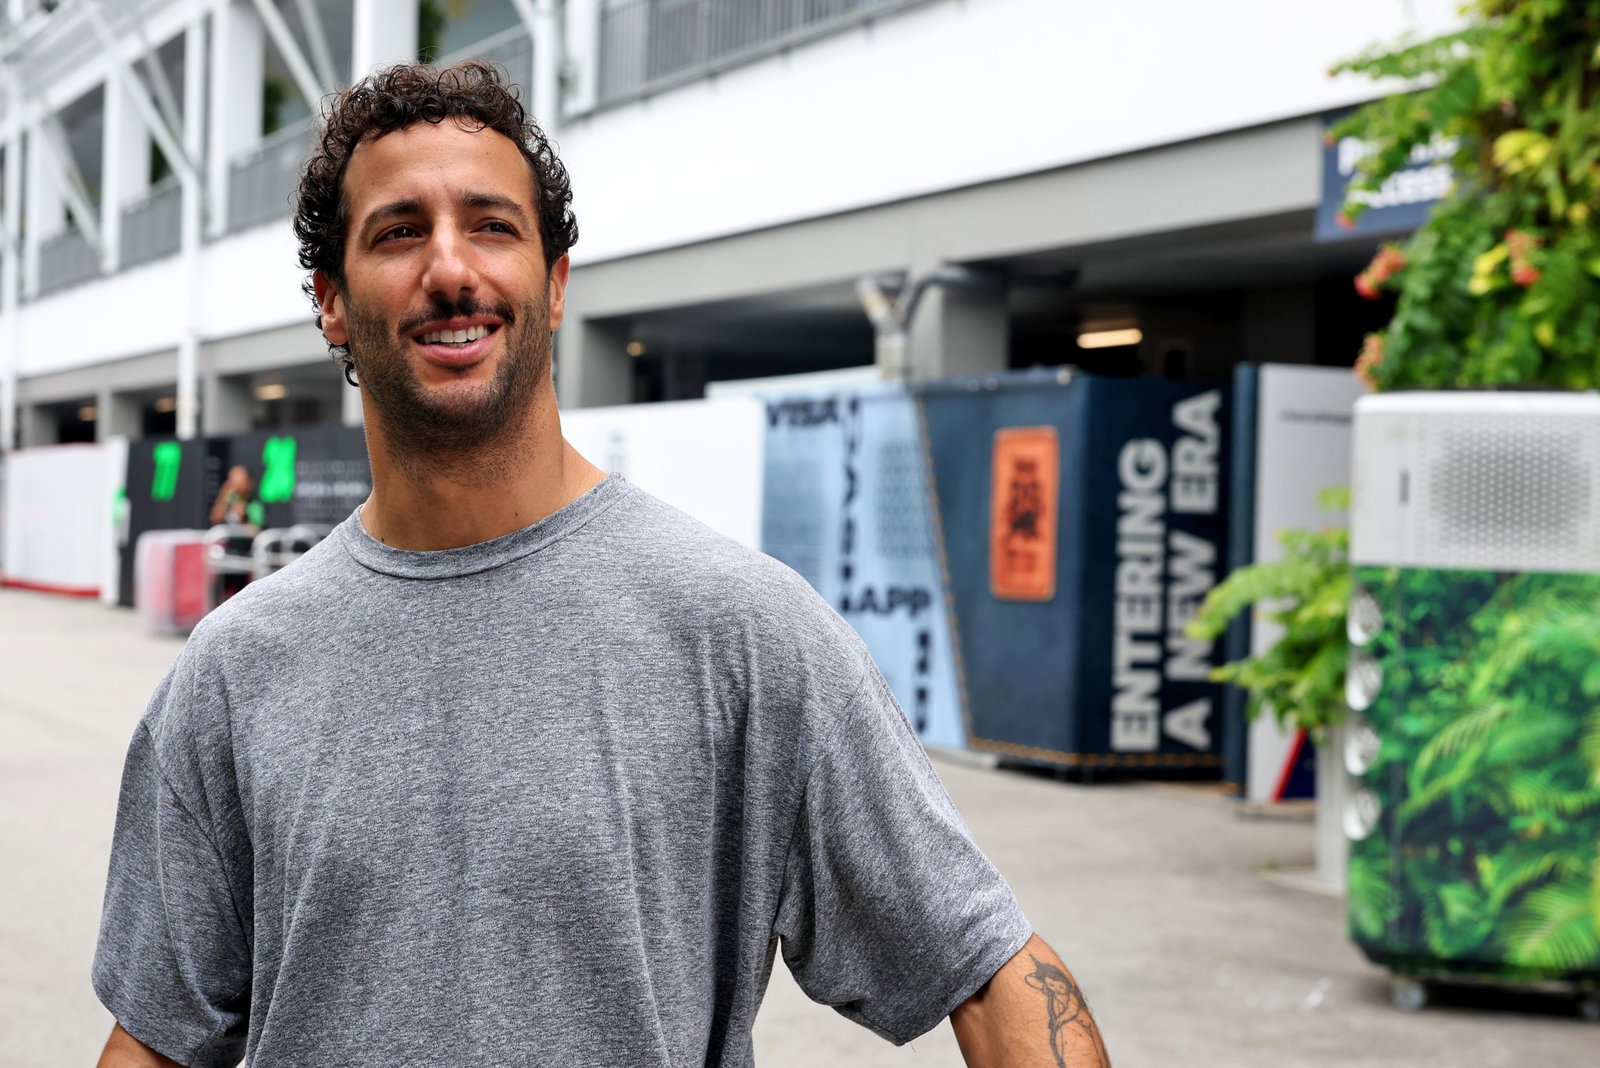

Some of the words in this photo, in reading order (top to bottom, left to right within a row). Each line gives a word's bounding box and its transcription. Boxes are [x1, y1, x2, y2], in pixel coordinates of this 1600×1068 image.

[1171, 390, 1221, 513] ERA
[1110, 438, 1167, 751] ENTERING
[1165, 532, 1216, 681] NEW
[1164, 697, 1212, 750] A
